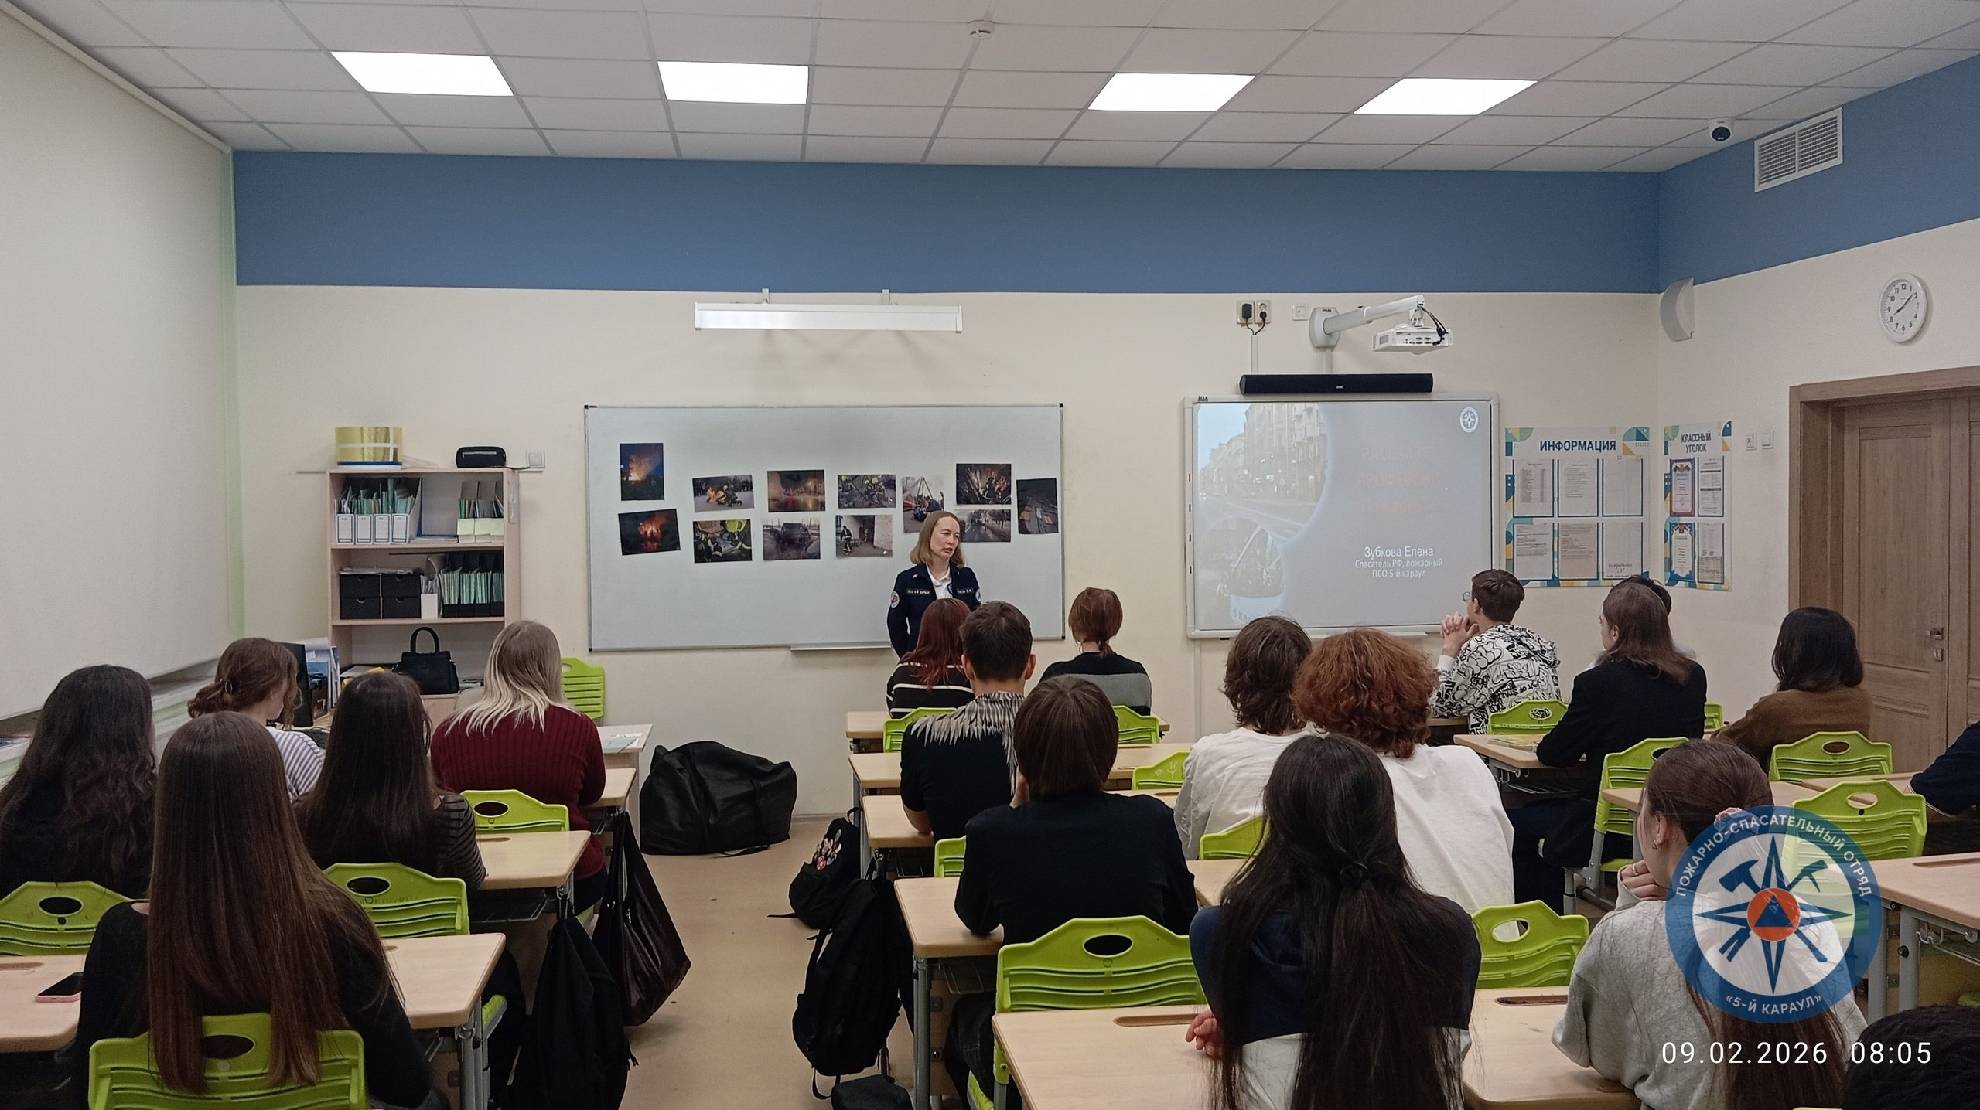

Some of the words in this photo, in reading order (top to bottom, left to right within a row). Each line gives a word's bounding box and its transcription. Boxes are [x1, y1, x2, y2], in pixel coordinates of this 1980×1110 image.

[1540, 440, 1617, 453] ИНФОРМАЦИЯ
[1685, 443, 1707, 453] УГОЛОК
[1364, 546, 1402, 560] Зубкова
[1404, 545, 1434, 557] Елена
